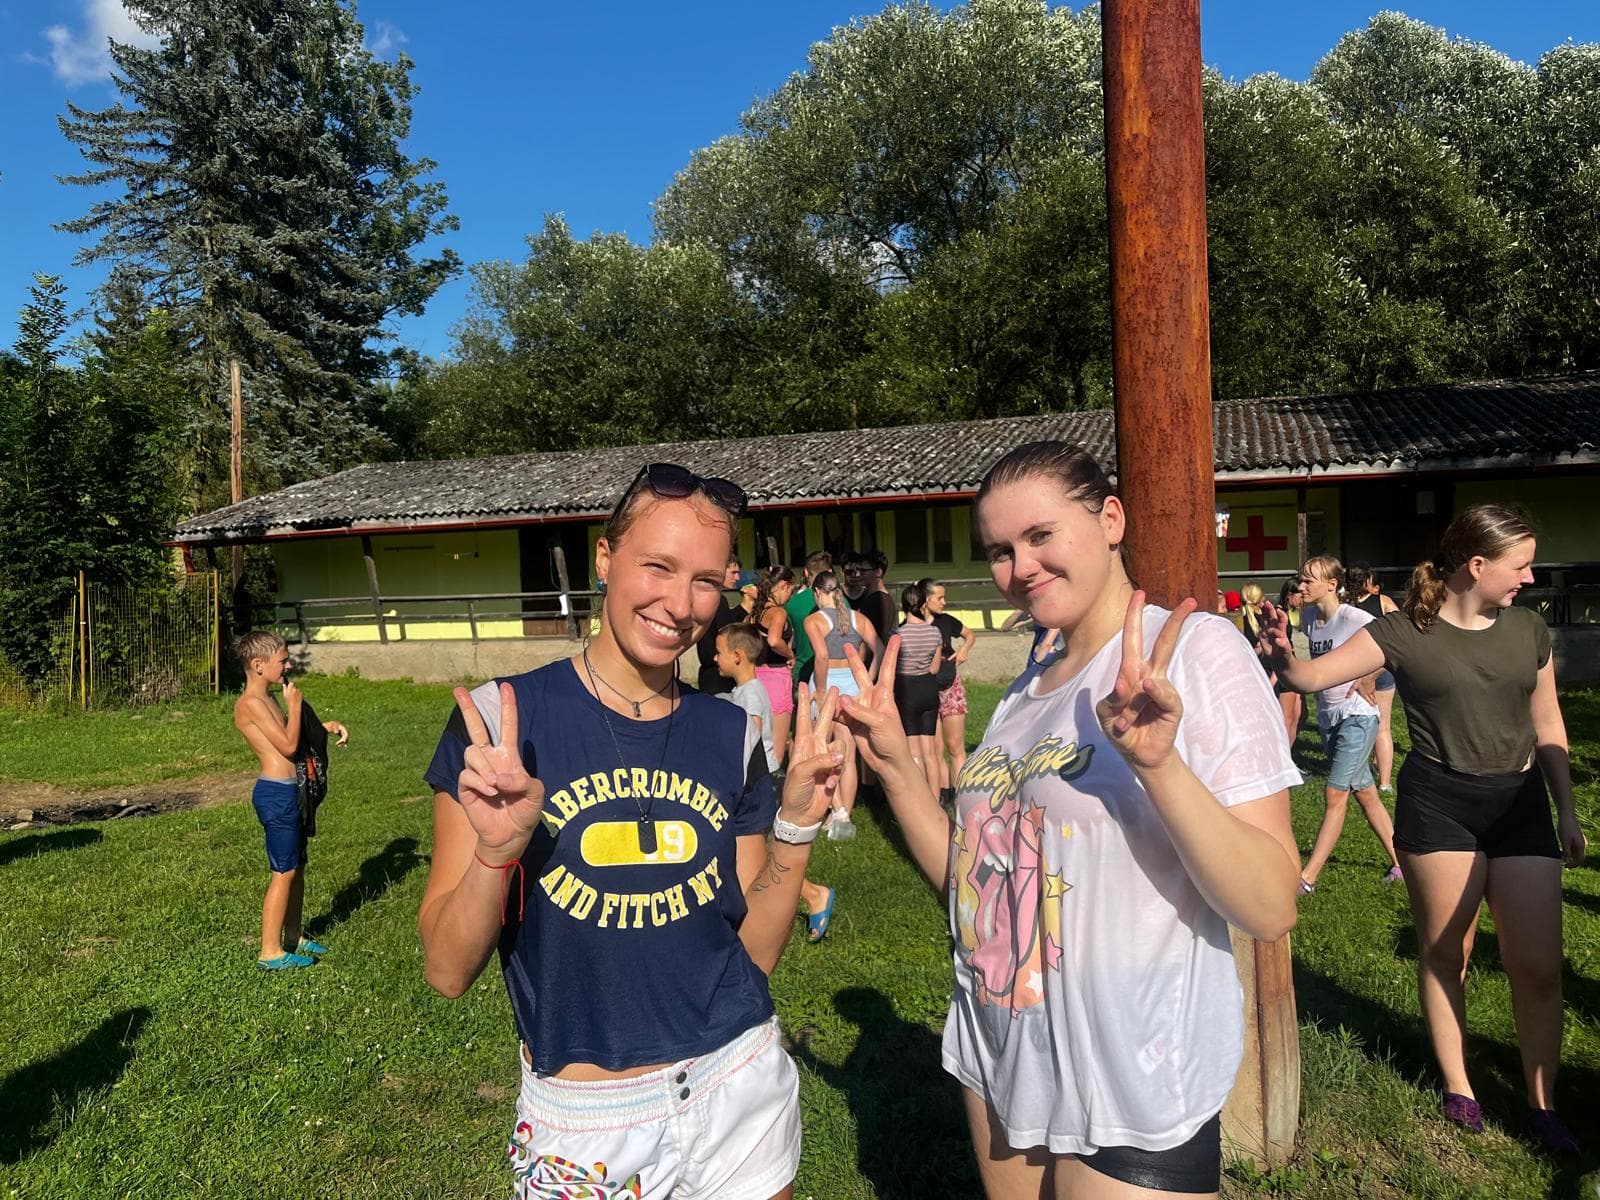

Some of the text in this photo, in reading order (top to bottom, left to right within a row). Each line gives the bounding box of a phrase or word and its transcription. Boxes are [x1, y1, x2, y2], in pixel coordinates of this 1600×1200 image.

[1323, 639, 1333, 651] DO
[541, 767, 729, 838] ABERCROMBIE
[539, 855, 723, 929] AND FITCH NY
